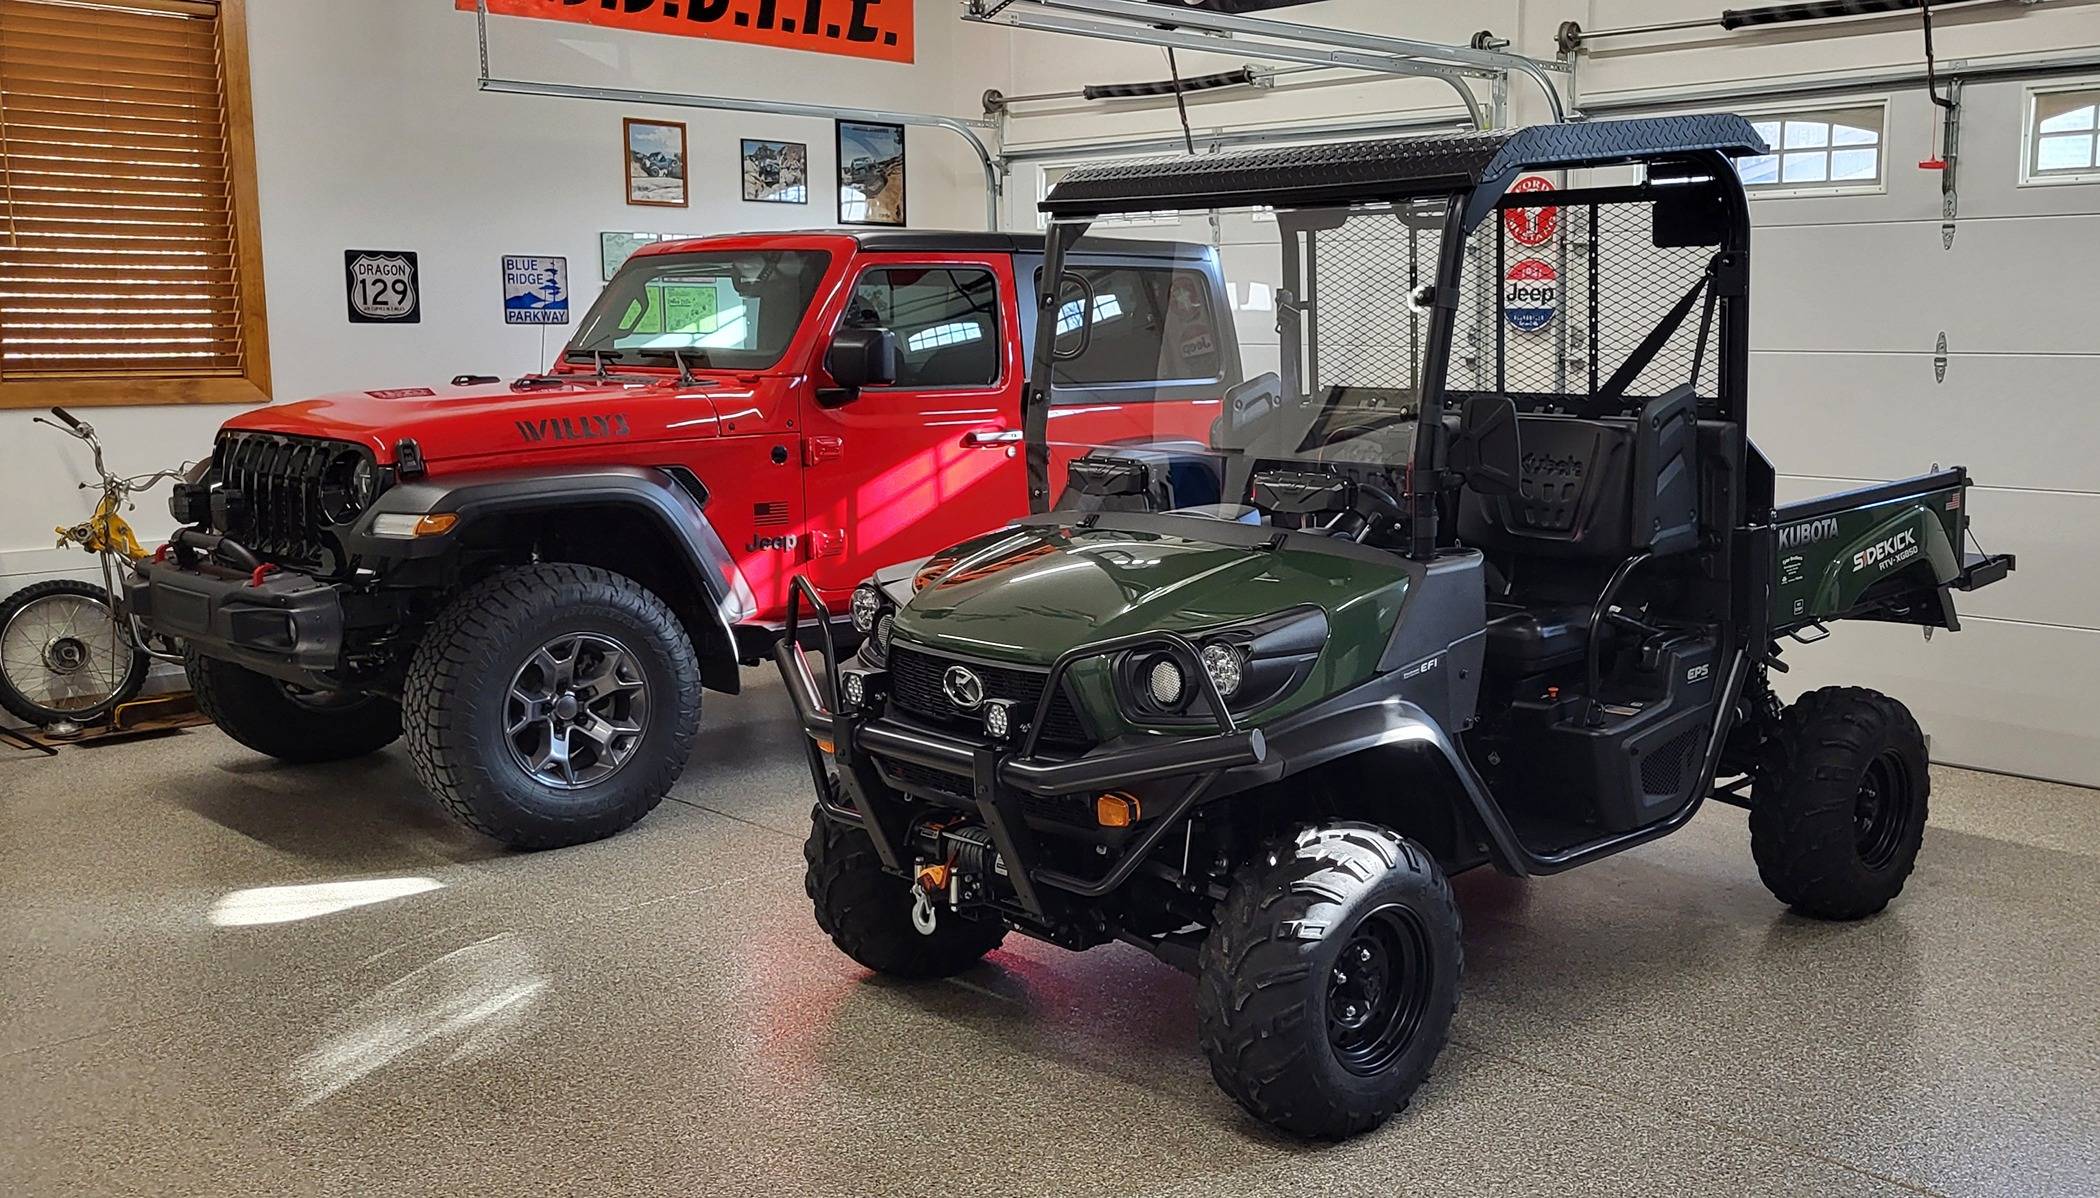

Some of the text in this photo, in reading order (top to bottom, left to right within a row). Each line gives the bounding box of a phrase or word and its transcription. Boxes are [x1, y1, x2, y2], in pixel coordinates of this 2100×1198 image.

[359, 263, 406, 276] DRAGON
[506, 259, 538, 271] BLUE
[507, 273, 544, 285] RIDGE
[359, 278, 408, 306] 129
[1507, 282, 1554, 306] Jeep
[508, 310, 566, 322] PARKWAY
[514, 413, 630, 442] WILLYS
[1778, 517, 1839, 550] KUBOTA
[745, 533, 798, 553] Jeep
[1852, 527, 1916, 573] SIDEKICK
[1420, 657, 1438, 673] EFI
[1687, 663, 1709, 680] EPS
